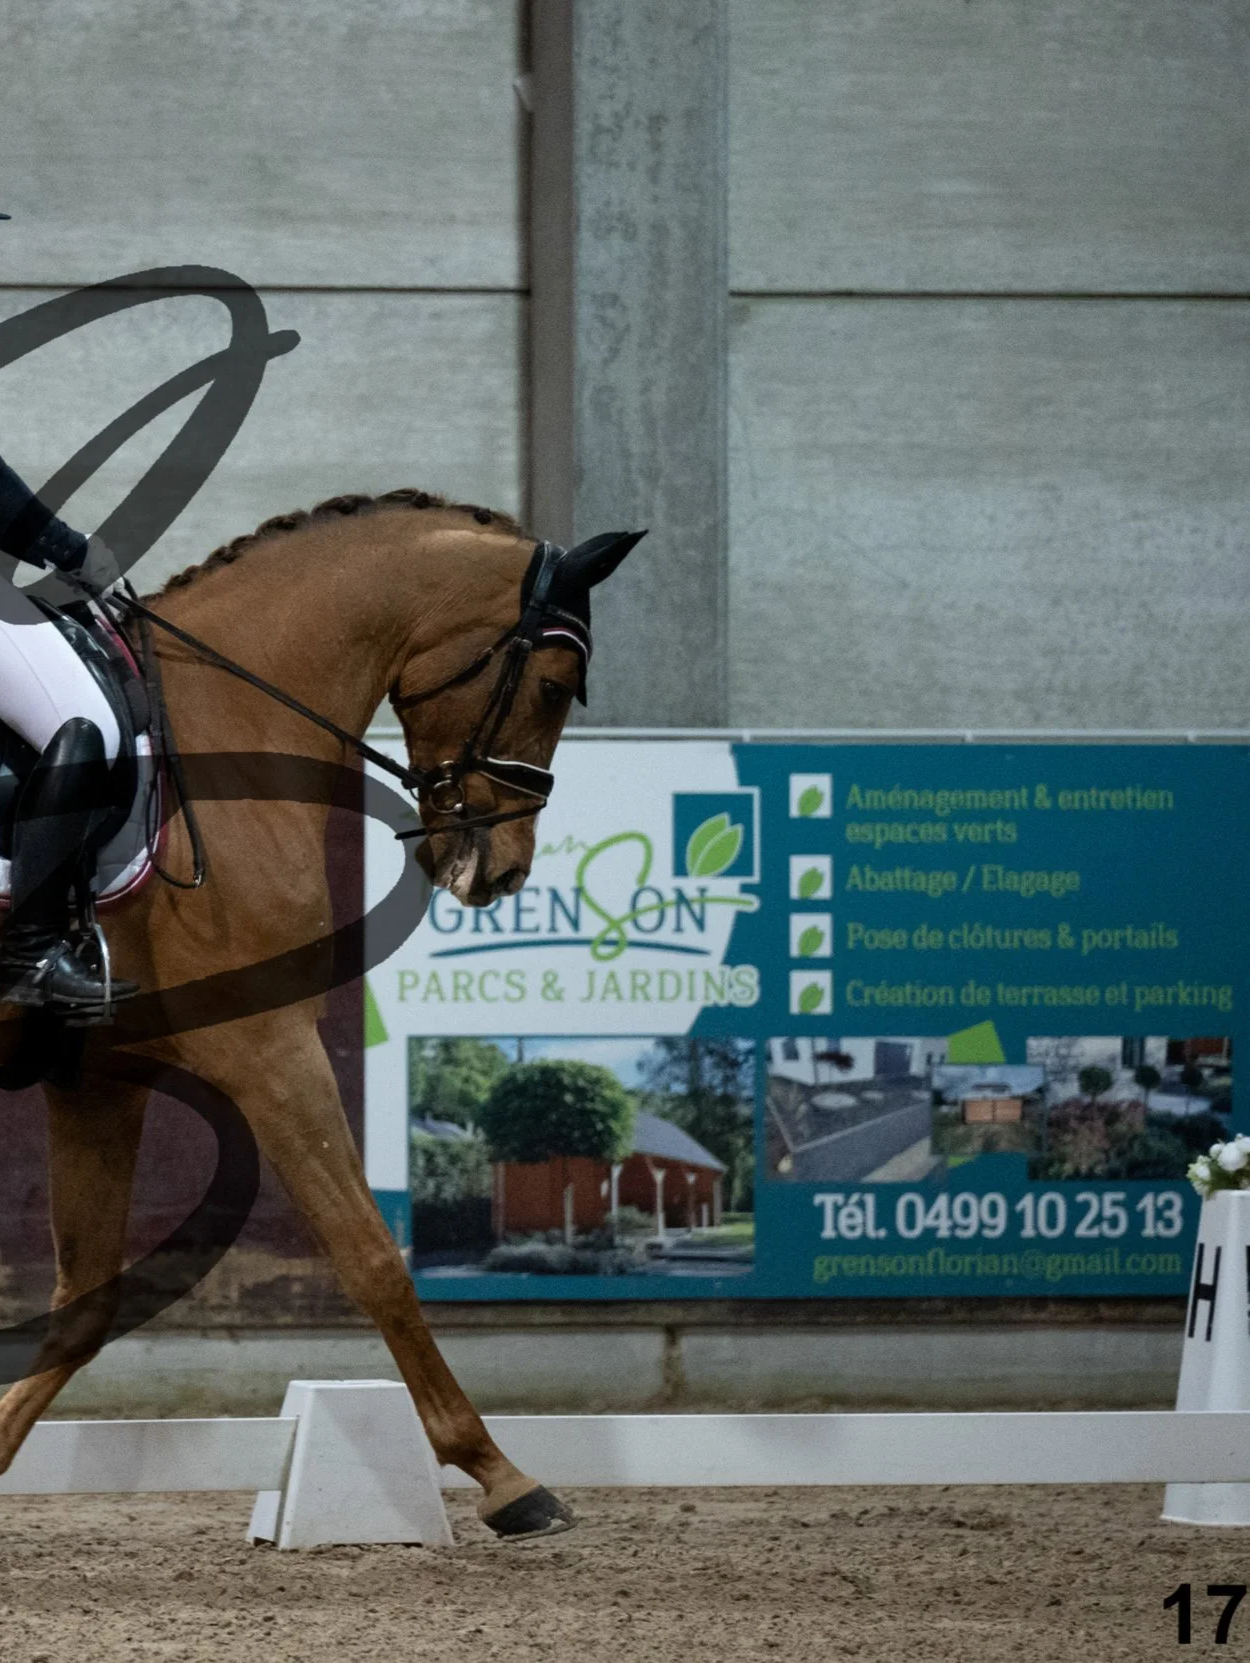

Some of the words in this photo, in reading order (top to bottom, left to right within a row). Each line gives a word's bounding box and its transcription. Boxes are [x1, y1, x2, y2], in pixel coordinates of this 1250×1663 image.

[845, 783, 1029, 816] Aménagement
[1034, 783, 1051, 810] &
[1058, 785, 1174, 811] entretien
[845, 821, 947, 849] espaces
[953, 819, 1018, 844] verts
[845, 864, 957, 897] Abattage
[846, 922, 908, 950] Pose
[912, 922, 943, 950] de
[949, 922, 1050, 950] clôtures
[1057, 922, 1076, 949] &
[1081, 922, 1180, 956] portails
[396, 970, 527, 1003] PARCS
[541, 970, 564, 1003] &
[580, 968, 758, 1005] JARDINS
[846, 979, 953, 1007] Création
[960, 980, 992, 1007] de
[997, 981, 1100, 1007] terrasse
[1104, 980, 1128, 1007] et
[1133, 980, 1234, 1012] parking
[813, 1192, 887, 1240] Tél.
[895, 1192, 1007, 1240] 0499
[1015, 1192, 1067, 1240] 10
[1075, 1192, 1128, 1239] 25
[1137, 1191, 1184, 1239] 13
[813, 1247, 1182, 1283] grensonflorian@gmail.com
[1187, 1243, 1222, 1342] H
